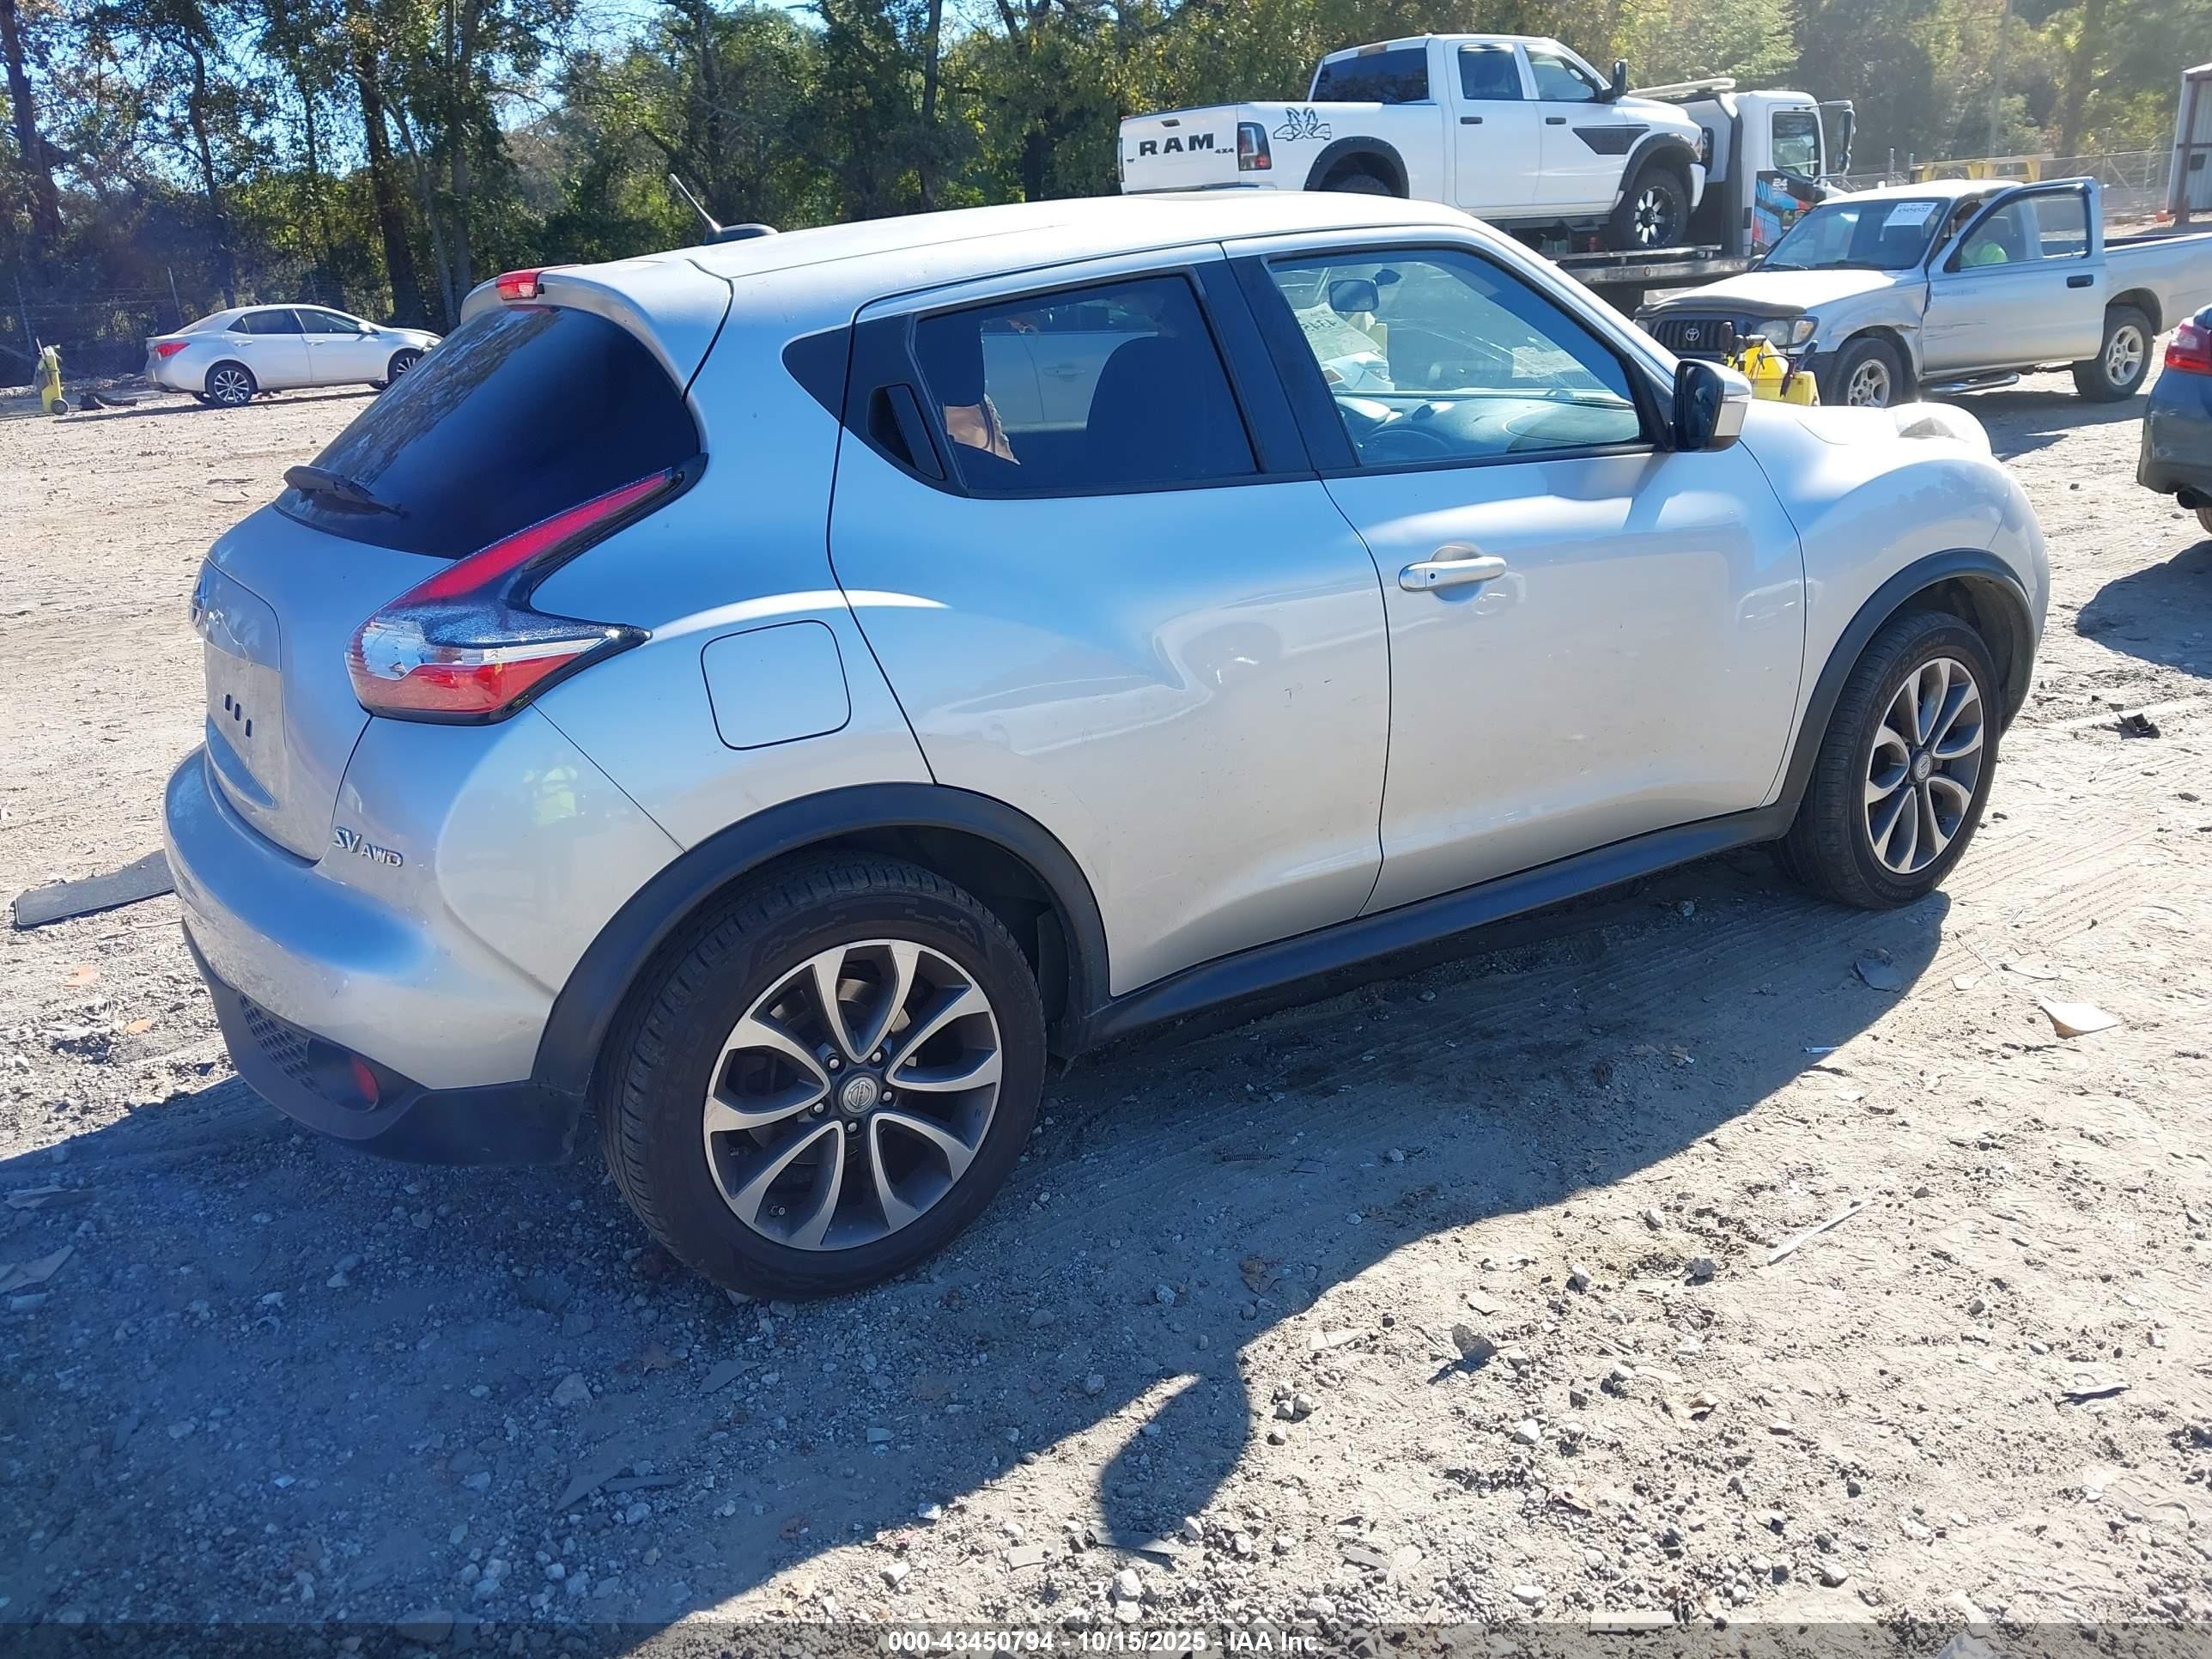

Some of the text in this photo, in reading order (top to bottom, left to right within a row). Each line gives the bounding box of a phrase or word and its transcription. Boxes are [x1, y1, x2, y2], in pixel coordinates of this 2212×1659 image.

[1140, 134, 1213, 156] RAM
[1772, 178, 1787, 186] 24
[332, 826, 404, 867] SV AWD
